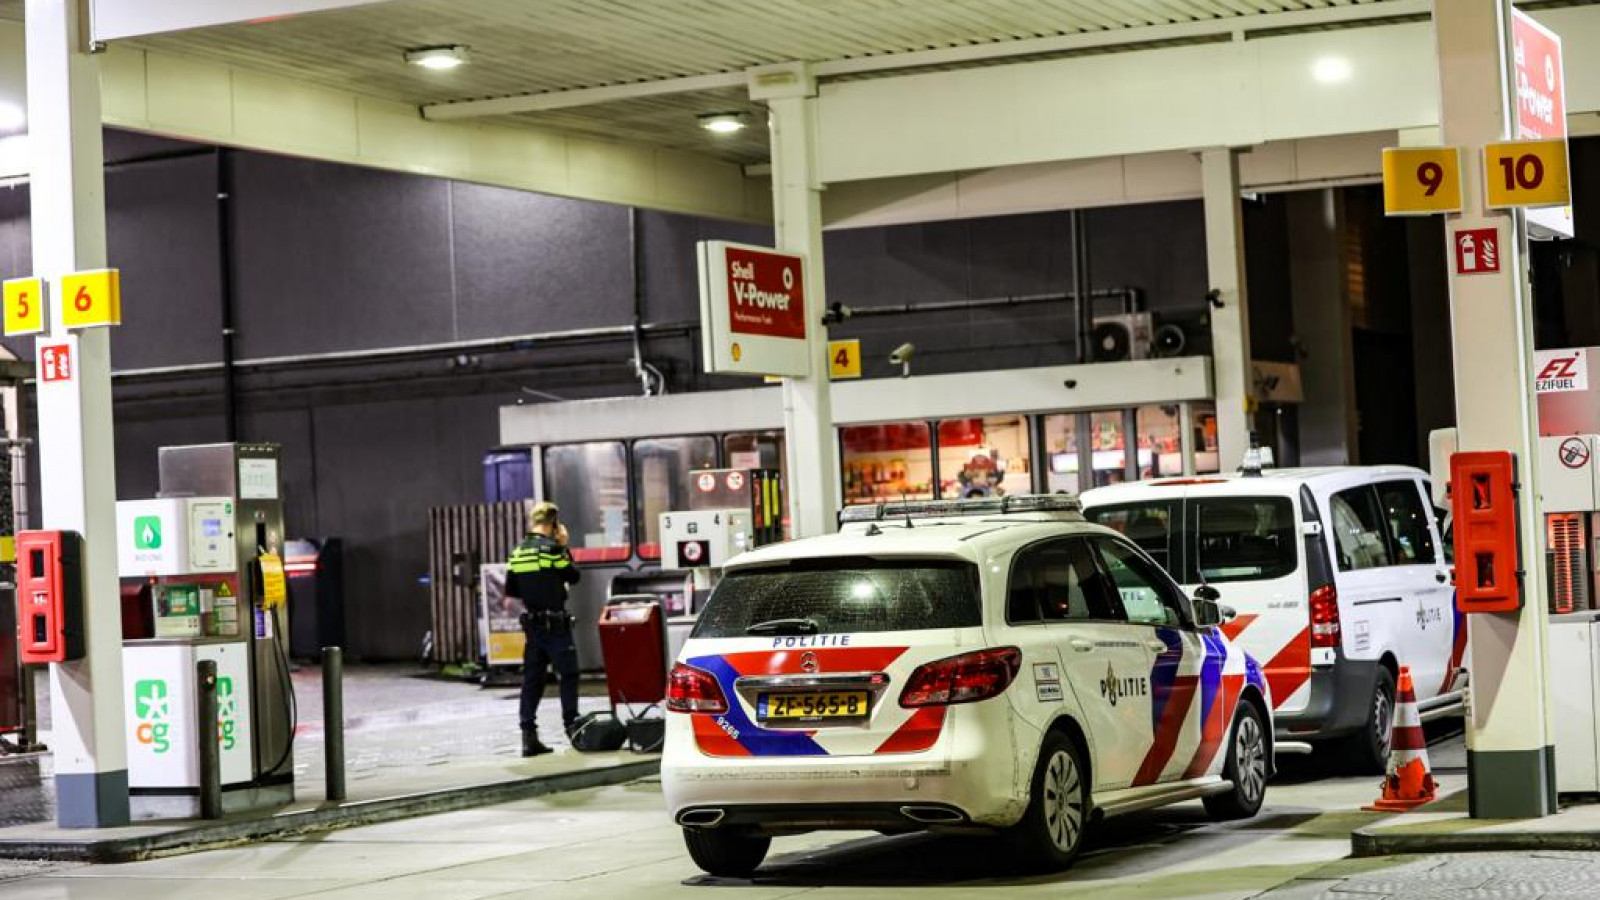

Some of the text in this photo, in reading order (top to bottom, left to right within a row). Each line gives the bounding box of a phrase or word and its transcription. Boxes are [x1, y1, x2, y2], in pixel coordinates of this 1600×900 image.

[1417, 162, 1443, 196] 9
[1499, 154, 1544, 190] 10
[732, 261, 754, 280] Shell
[17, 291, 30, 319] 5
[74, 285, 93, 312] 6
[733, 281, 790, 310] V-Power
[835, 349, 849, 367] 4
[1536, 379, 1575, 391] EZIFUEL
[665, 516, 673, 529] 3
[772, 635, 851, 648] POLITIE
[1100, 676, 1147, 706] POLITIE
[774, 695, 859, 716] ZF-565-B
